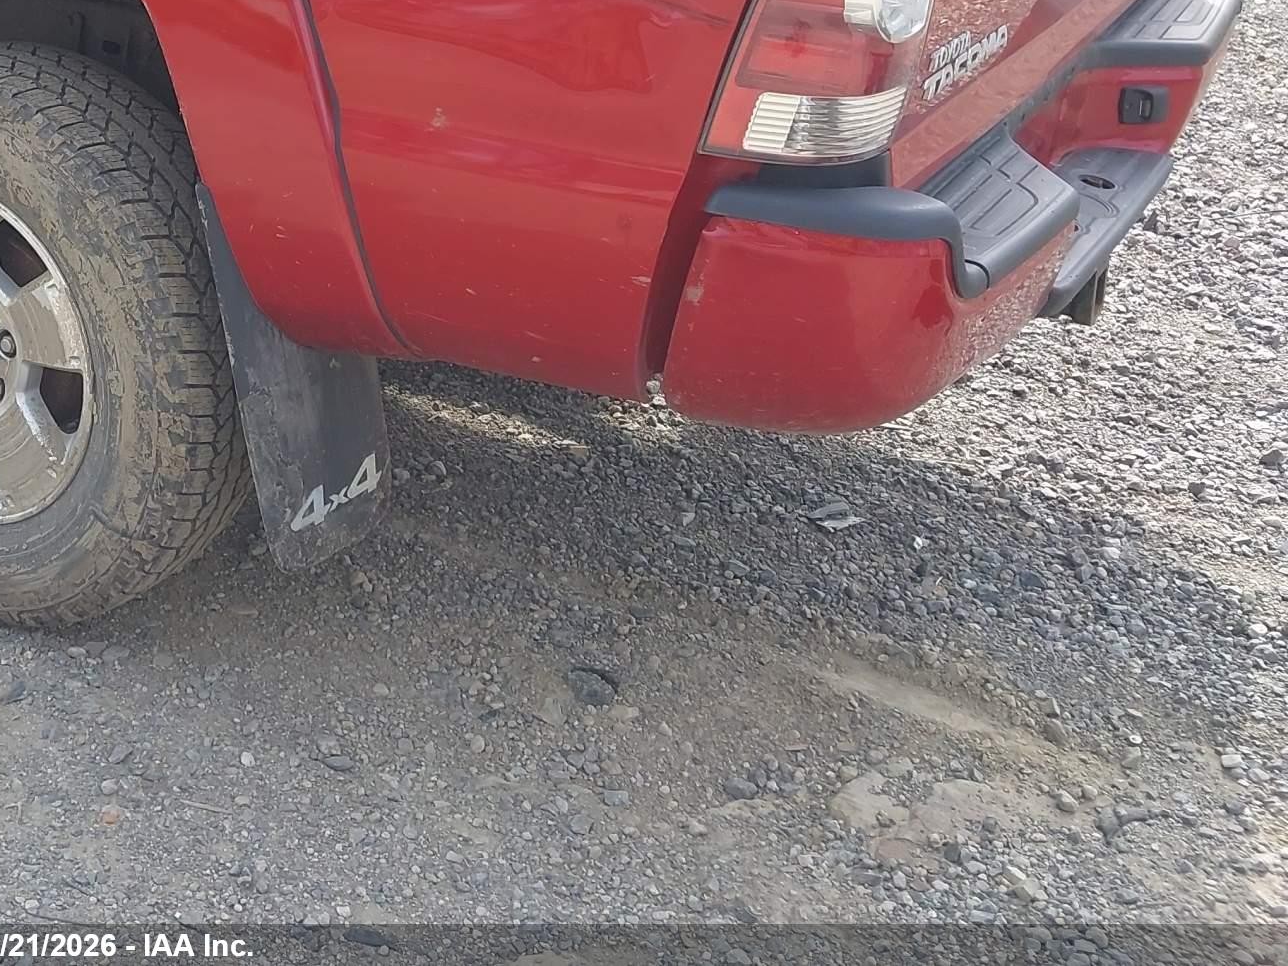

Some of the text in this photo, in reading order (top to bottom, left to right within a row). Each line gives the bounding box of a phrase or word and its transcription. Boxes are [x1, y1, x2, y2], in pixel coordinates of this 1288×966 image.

[921, 24, 1009, 101] TACOMA
[929, 30, 972, 72] TOYOTA
[290, 453, 383, 532] 4x4
